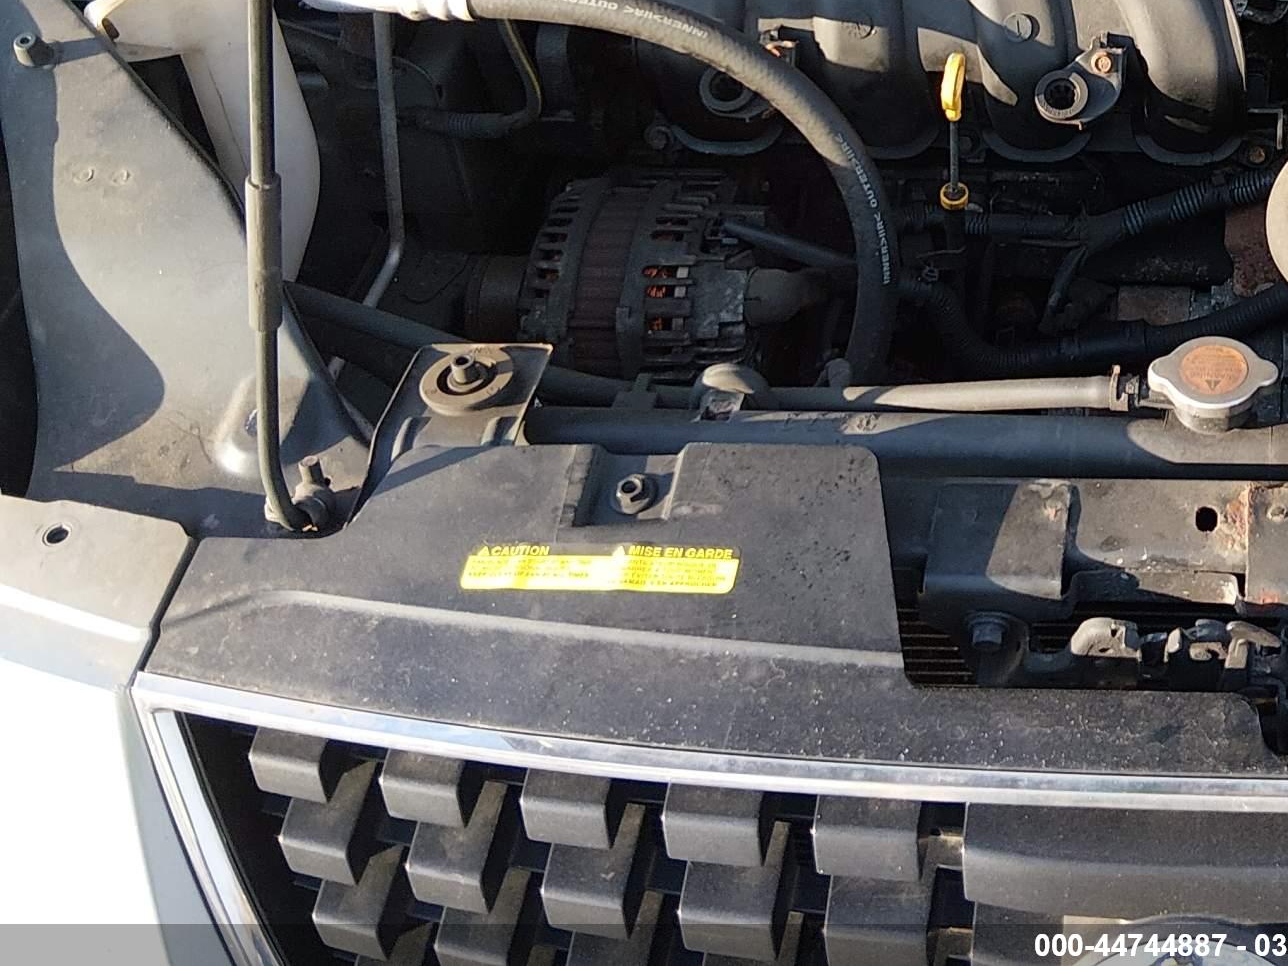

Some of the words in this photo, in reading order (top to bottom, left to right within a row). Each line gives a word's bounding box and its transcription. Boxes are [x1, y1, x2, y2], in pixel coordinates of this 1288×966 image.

[491, 545, 550, 557] CAUTION
[628, 545, 663, 557] MISE
[666, 546, 685, 558] EN
[686, 547, 733, 560] GARDE
